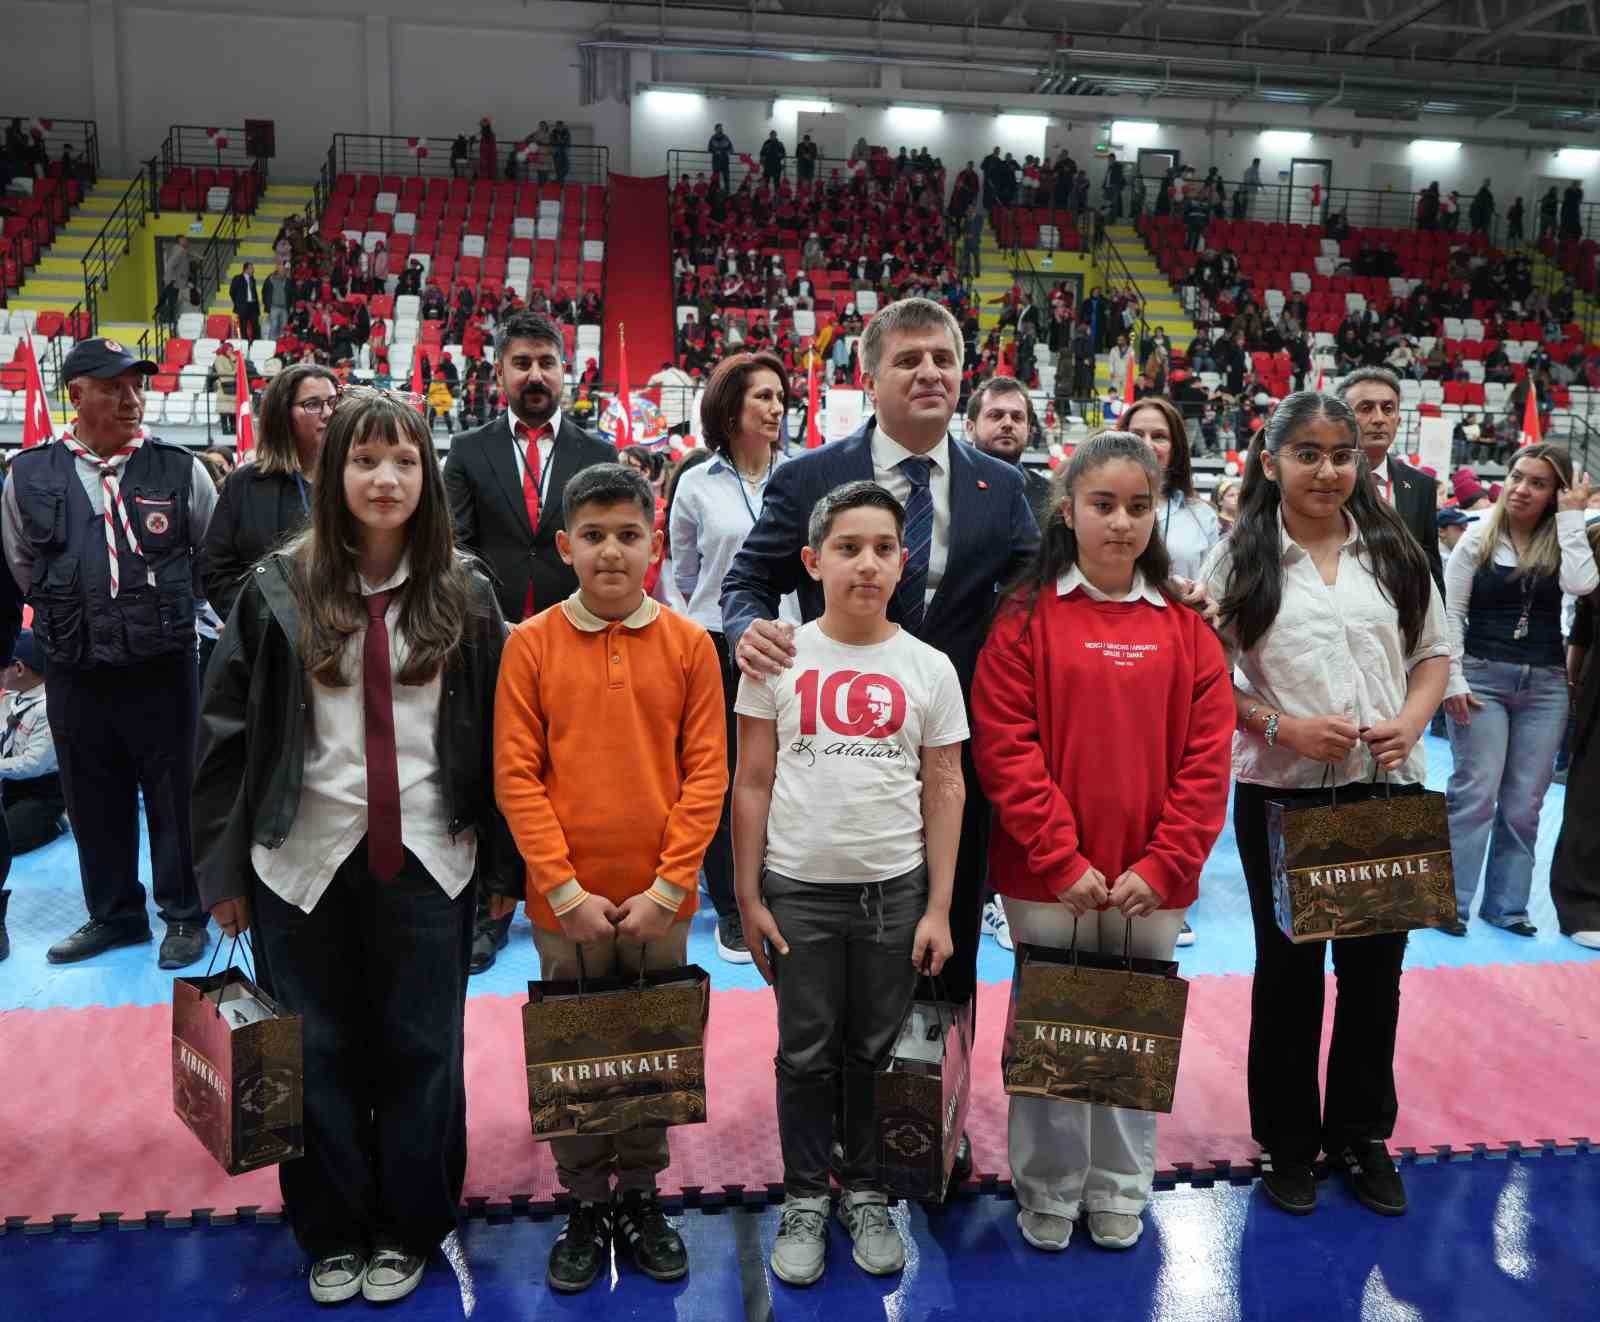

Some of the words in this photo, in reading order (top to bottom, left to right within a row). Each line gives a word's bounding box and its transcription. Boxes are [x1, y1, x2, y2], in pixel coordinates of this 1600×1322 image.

[794, 668, 907, 740] 100
[1309, 858, 1430, 887] KIRIKKALE
[1034, 1024, 1156, 1054] KIRIKKALE
[180, 1046, 227, 1103] KIRIKKALE
[551, 1054, 679, 1083] KIRIKKALE
